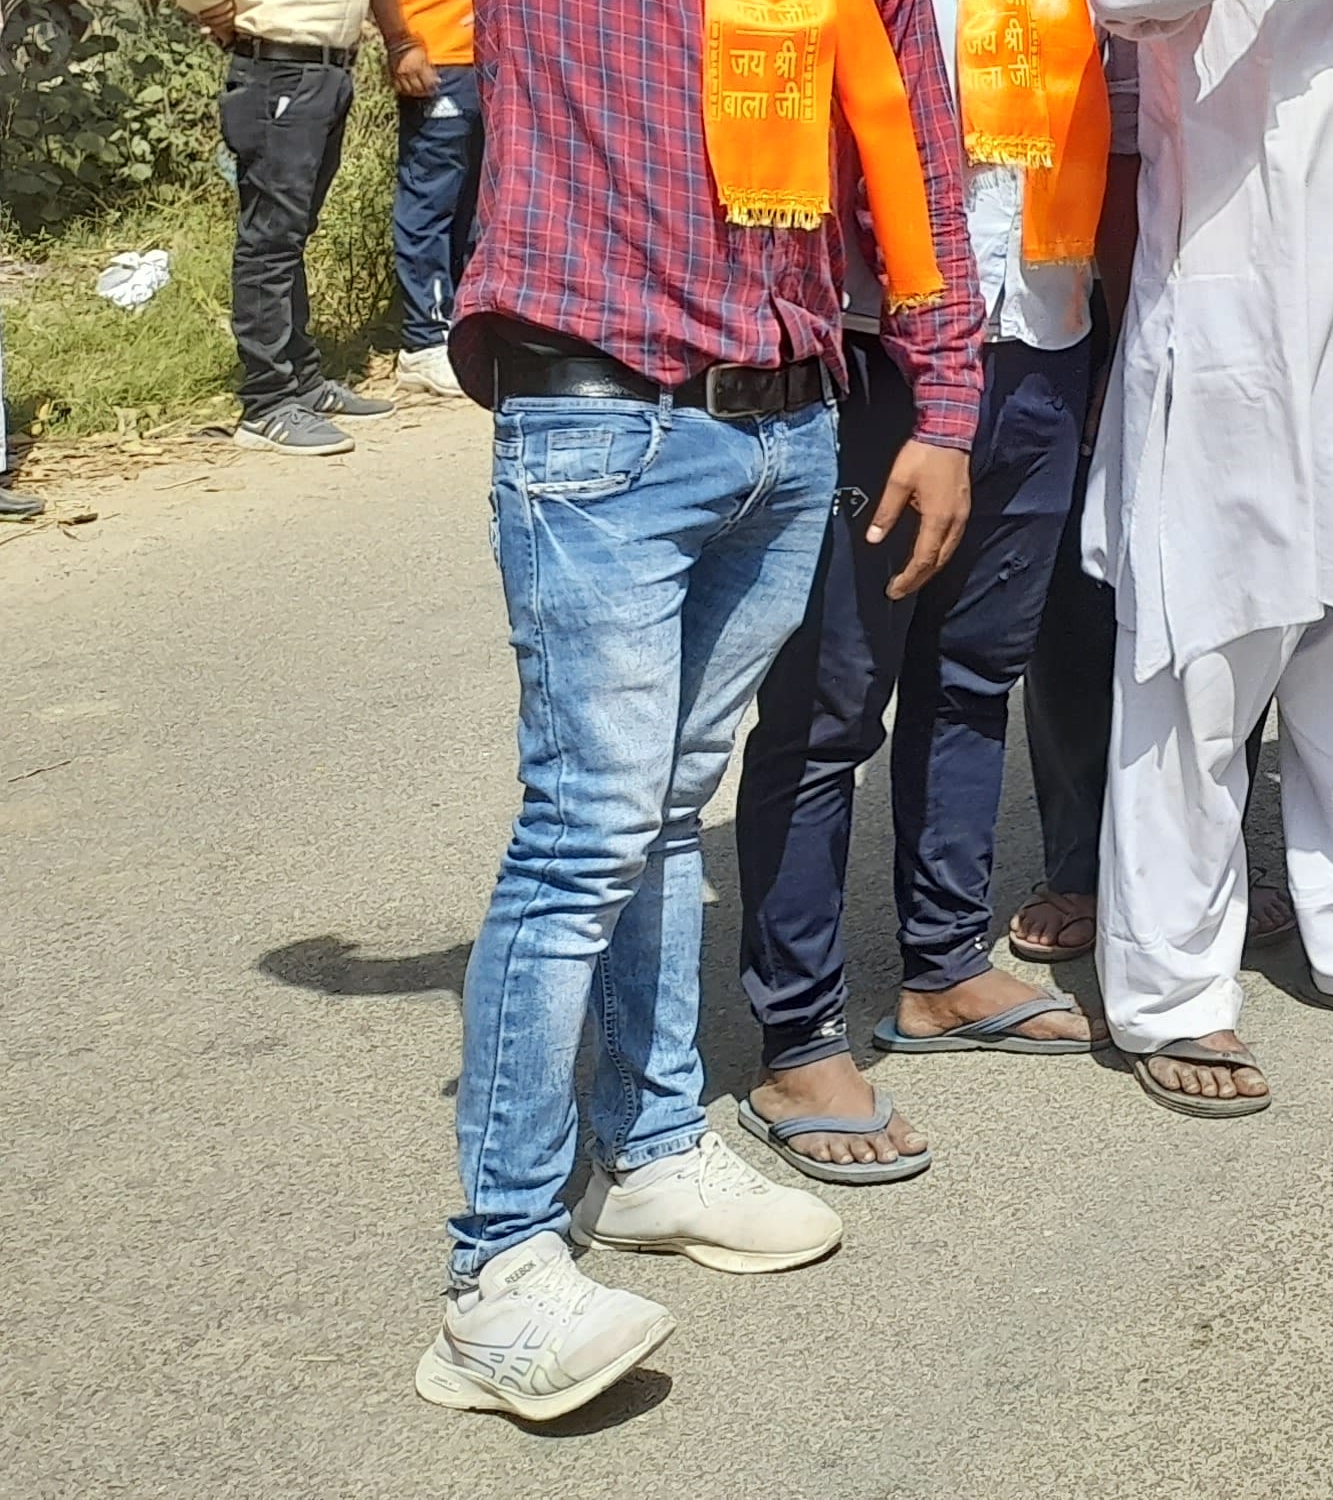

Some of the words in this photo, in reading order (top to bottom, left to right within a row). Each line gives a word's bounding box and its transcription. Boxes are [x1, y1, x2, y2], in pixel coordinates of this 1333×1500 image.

[967, 31, 998, 55] जय
[1004, 18, 1023, 52] श्री
[729, 49, 767, 77] जय
[774, 40, 798, 80] श्री
[1008, 54, 1030, 88] जी
[722, 90, 769, 120] बाला
[775, 81, 801, 120] जी
